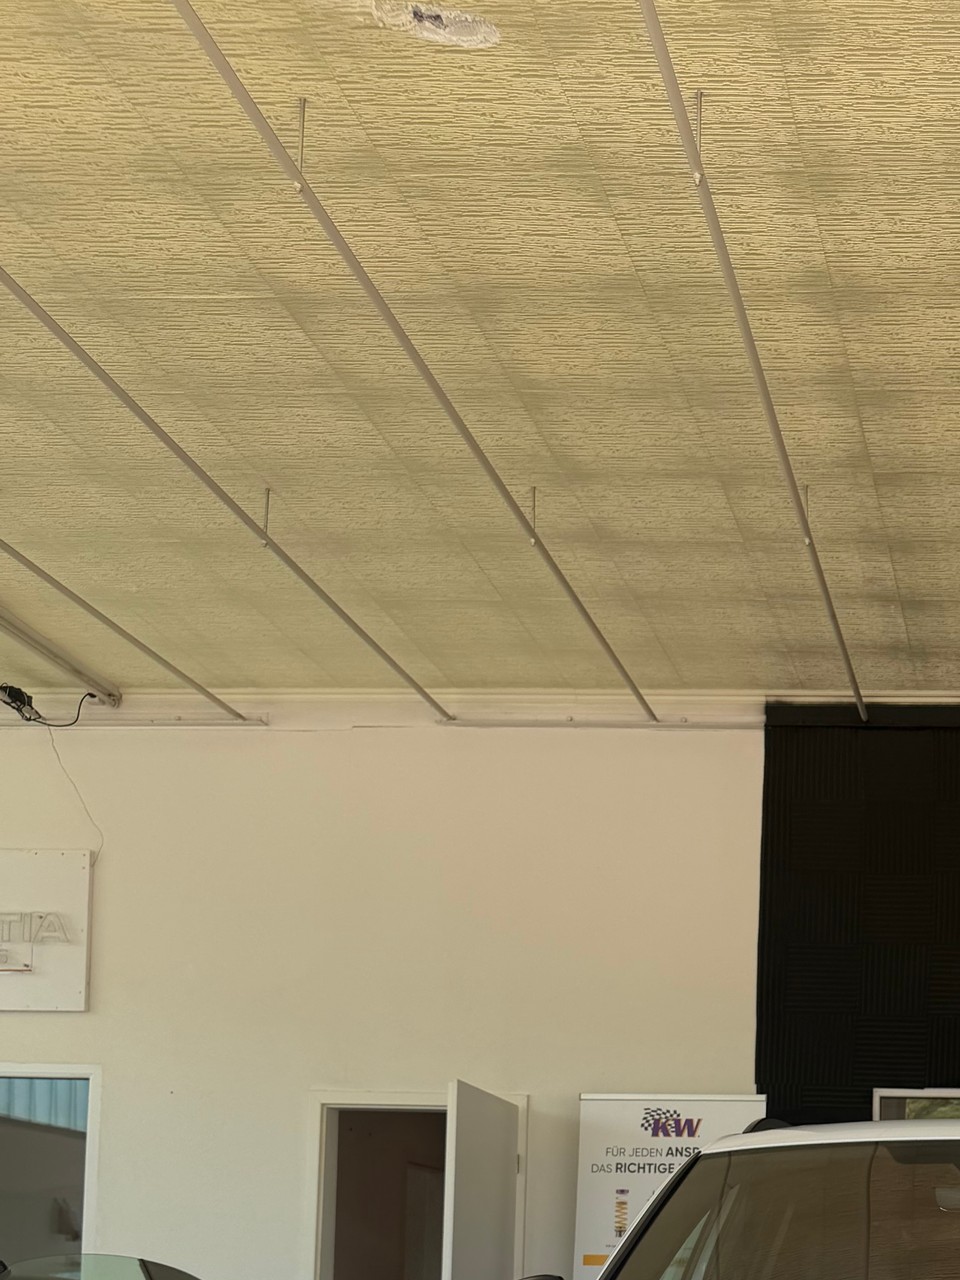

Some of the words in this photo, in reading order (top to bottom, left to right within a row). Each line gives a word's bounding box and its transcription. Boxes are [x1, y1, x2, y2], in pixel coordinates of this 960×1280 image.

[651, 1118, 703, 1138] KW
[605, 1146, 626, 1158] FÜR
[628, 1147, 664, 1158] JEDEN
[591, 1163, 613, 1174] DAS
[614, 1162, 675, 1174] RICHTIGE
